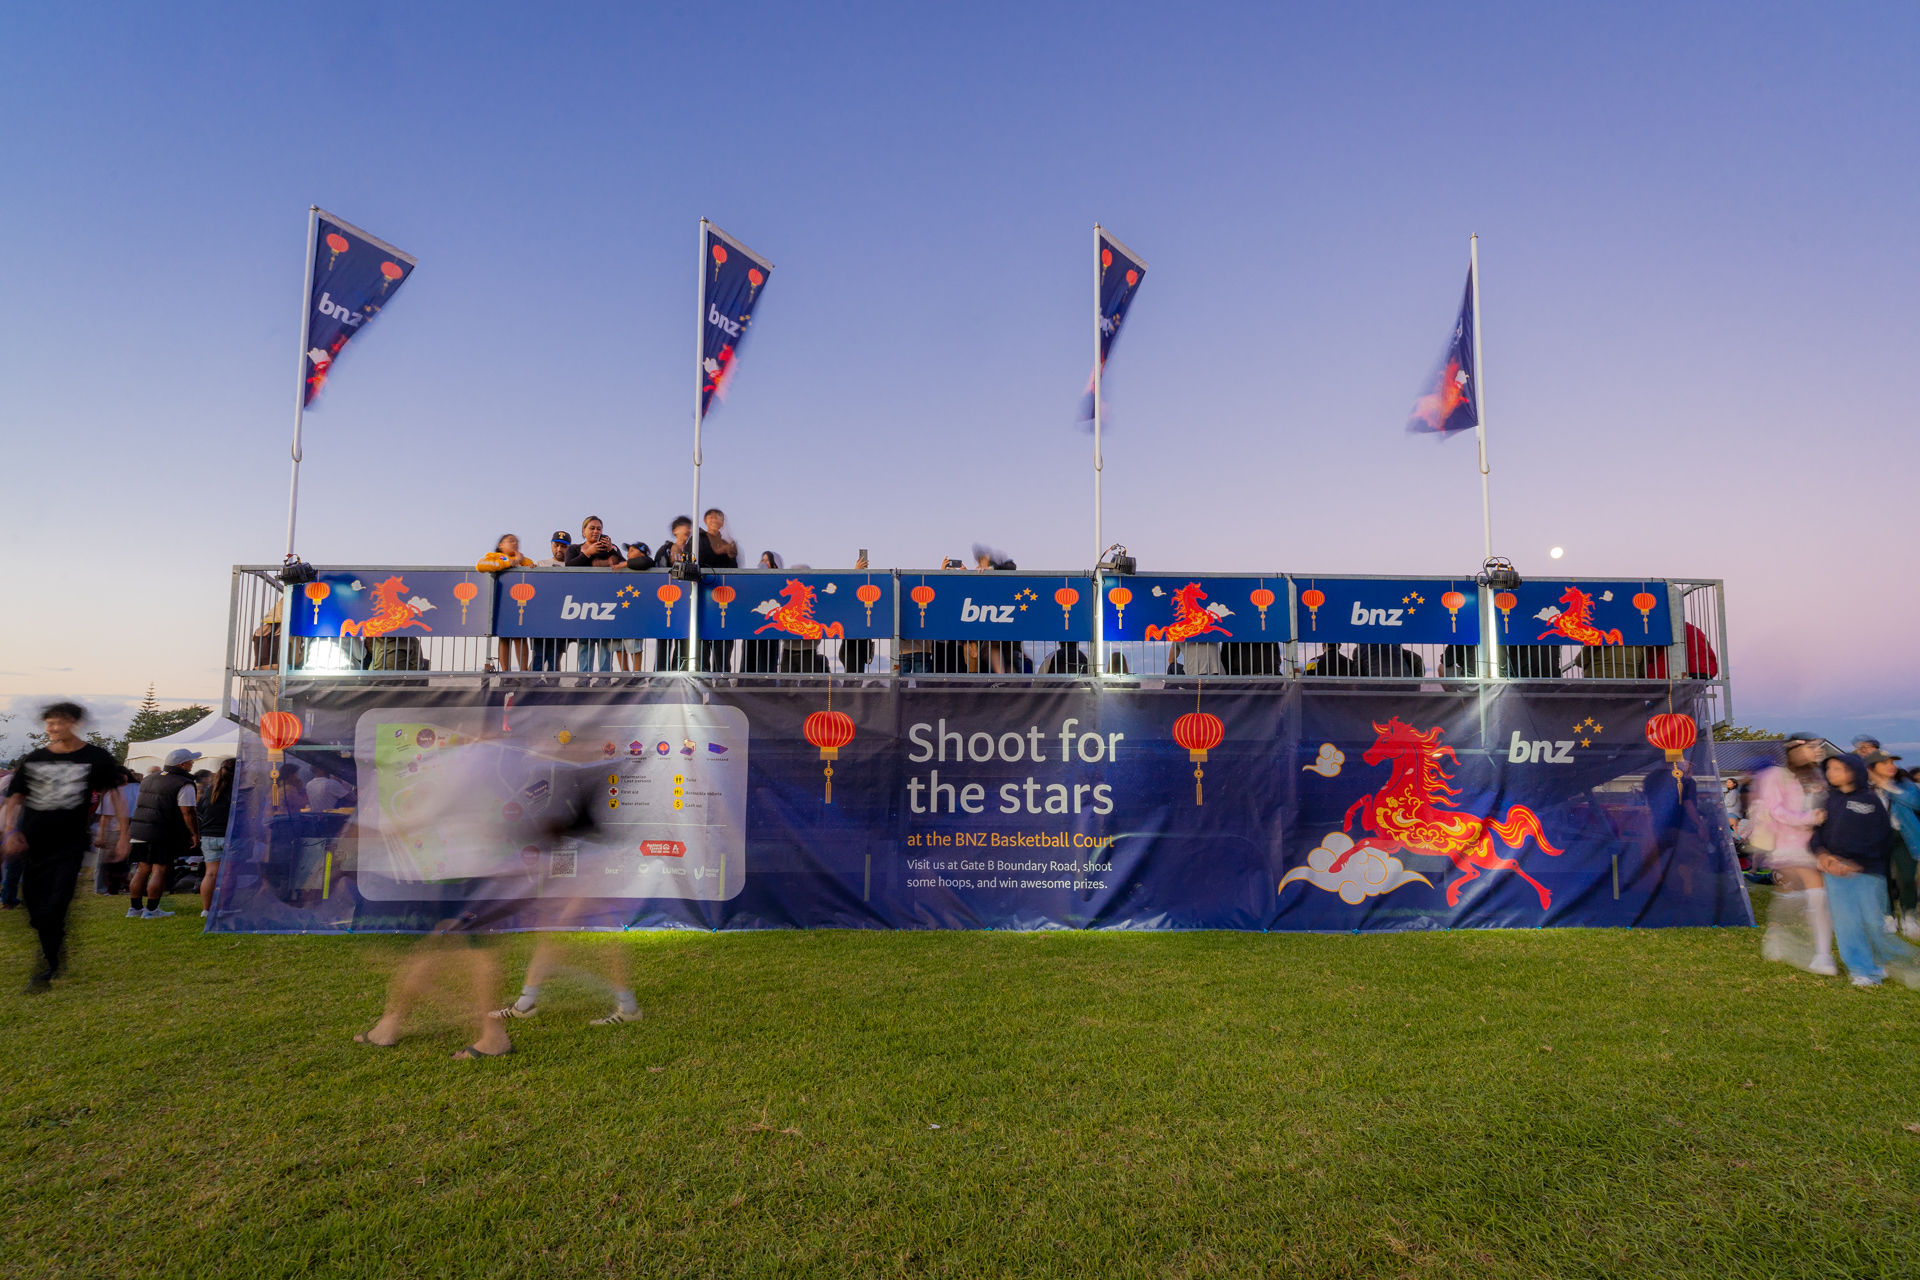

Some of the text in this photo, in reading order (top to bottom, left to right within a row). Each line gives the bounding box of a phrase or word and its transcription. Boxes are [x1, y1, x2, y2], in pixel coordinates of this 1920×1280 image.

[318, 292, 364, 327] bnz
[708, 303, 741, 338] bnz
[561, 594, 617, 621] bnz
[961, 597, 1015, 623] bnz
[1351, 601, 1403, 626] bnz
[908, 718, 1125, 763] Shoot for
[1508, 730, 1575, 764] bnz
[907, 769, 1114, 815] the stars
[907, 831, 1114, 848] at the BNZ Basketball Court
[907, 860, 1112, 873] Visit us at Gate B Boundary Road, shoot
[907, 876, 1108, 891] some hoops, and win awesome prizes.
